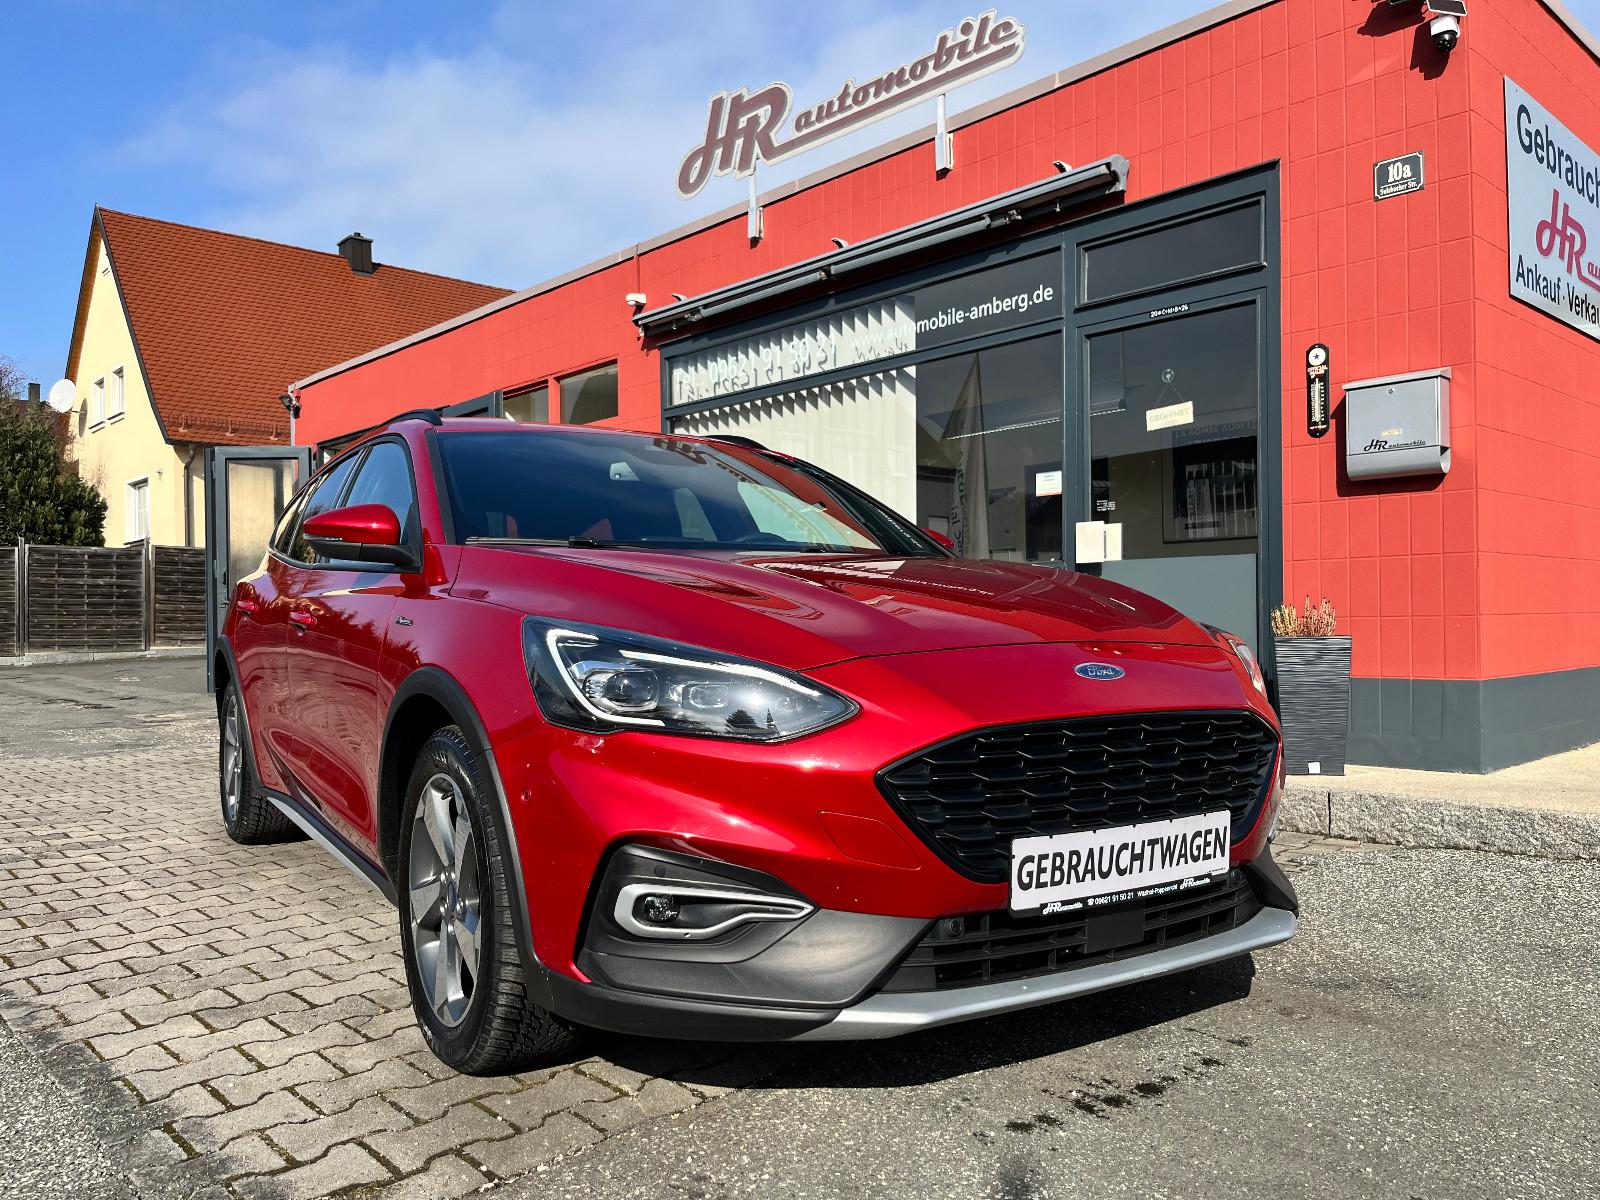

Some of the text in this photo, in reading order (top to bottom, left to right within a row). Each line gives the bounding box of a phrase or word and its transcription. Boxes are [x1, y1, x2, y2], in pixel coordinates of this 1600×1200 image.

[678, 13, 1019, 195] HR automobile
[1388, 161, 1412, 183] 10a
[1408, 180, 1418, 189] Str.
[1536, 188, 1587, 274] HR
[1516, 254, 1561, 306] Ankauf
[709, 352, 755, 383] 09621
[761, 345, 781, 371] 91
[789, 337, 810, 364] 50
[816, 331, 837, 358] 21
[1363, 439, 1388, 452] HR
[1087, 665, 1115, 676] Ford
[1017, 826, 1228, 892] GEBRAUCHTWAGEN
